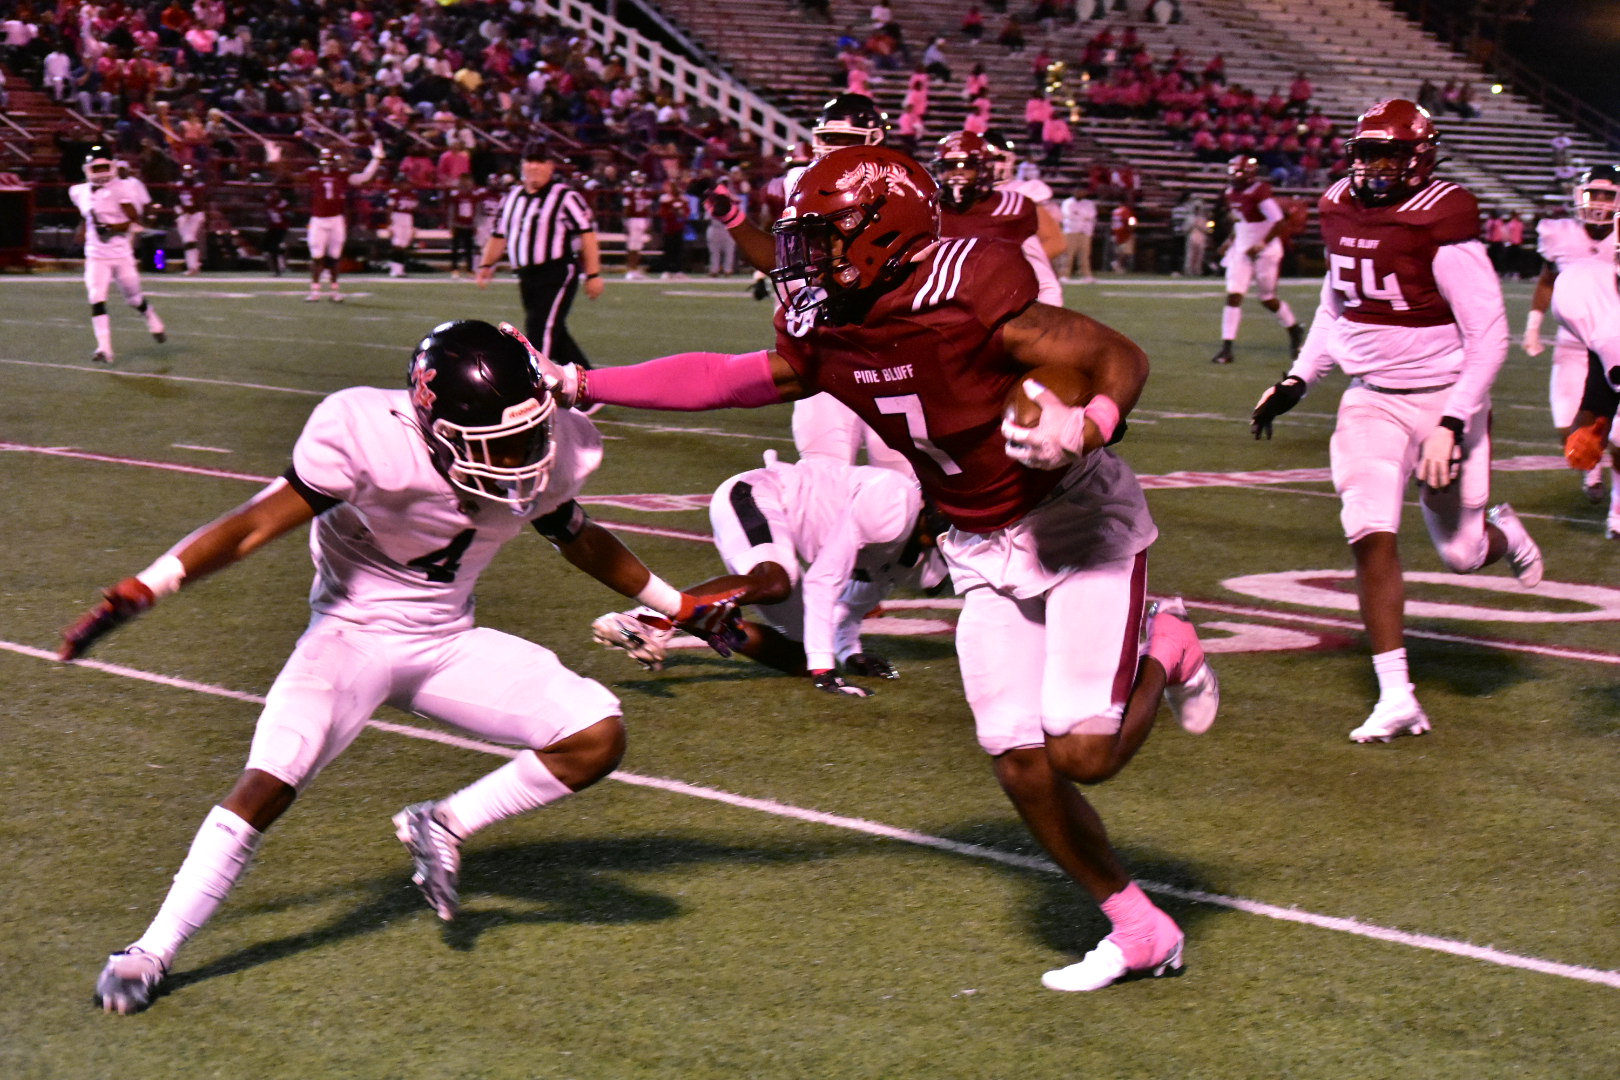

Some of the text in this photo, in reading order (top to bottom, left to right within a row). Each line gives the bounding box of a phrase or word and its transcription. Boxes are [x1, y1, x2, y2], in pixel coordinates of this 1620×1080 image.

[1339, 236, 1381, 250] PINE BLUFF
[1330, 253, 1411, 311] 54
[853, 363, 914, 384] PINE BLUFF
[873, 393, 963, 476] 7
[406, 527, 478, 583] 4
